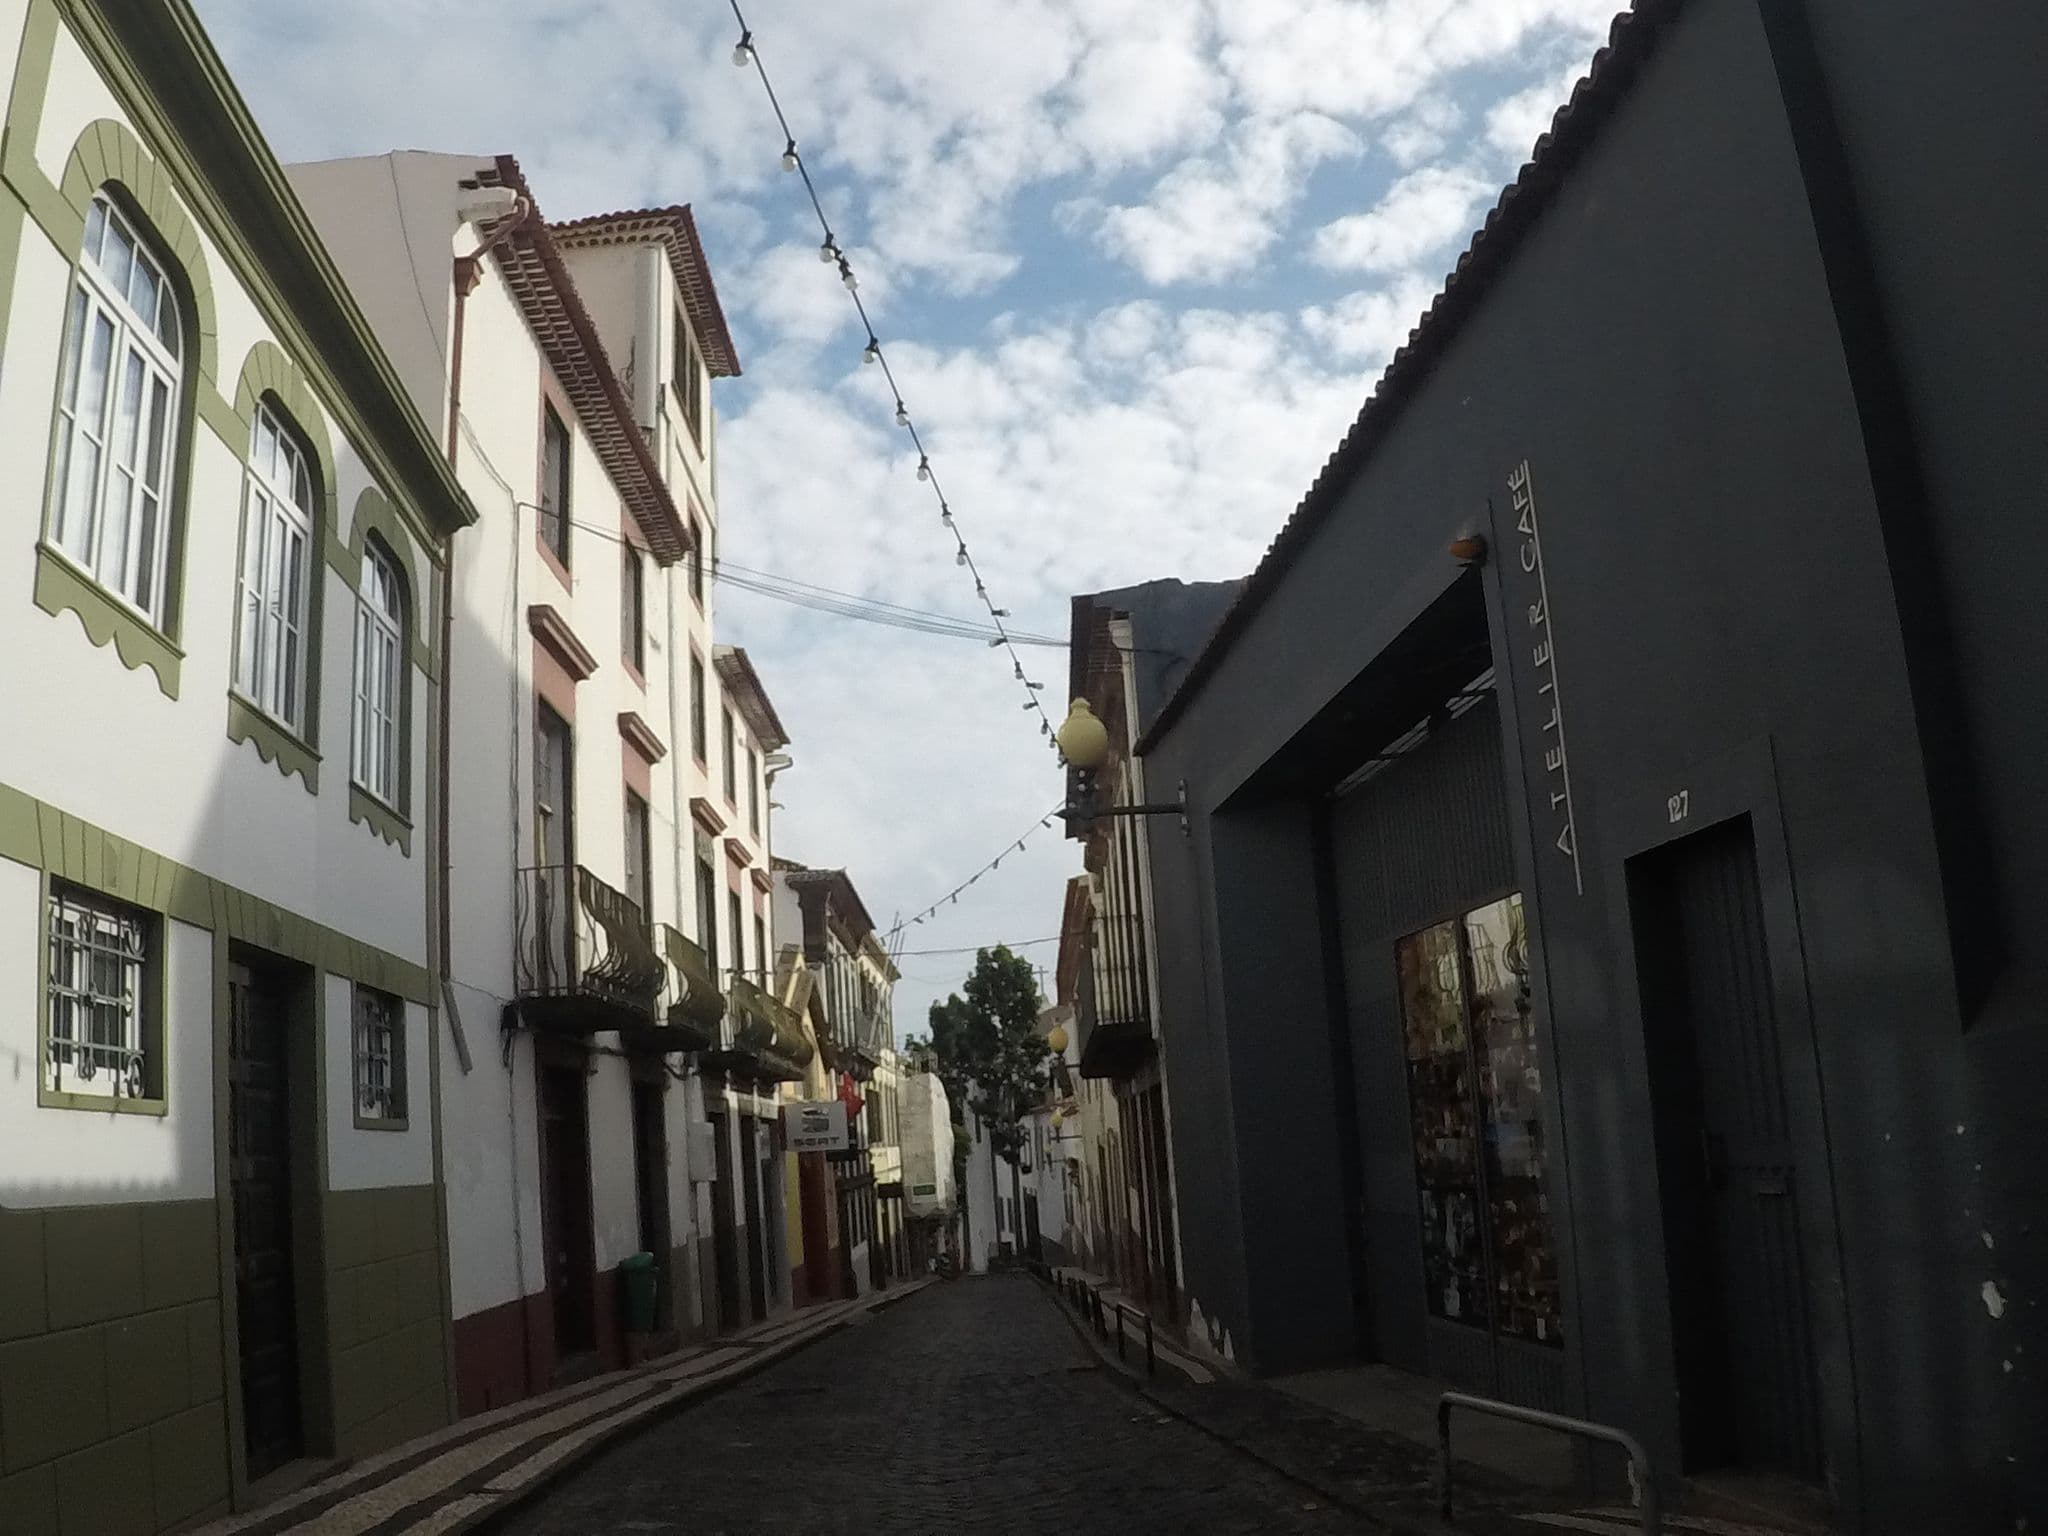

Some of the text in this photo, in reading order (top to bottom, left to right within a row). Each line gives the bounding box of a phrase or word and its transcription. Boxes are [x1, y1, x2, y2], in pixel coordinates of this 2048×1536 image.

[1507, 463, 1572, 856] ATELIER CAFÉ
[1668, 790, 1688, 823] 127
[793, 1136, 840, 1147] SEAT
